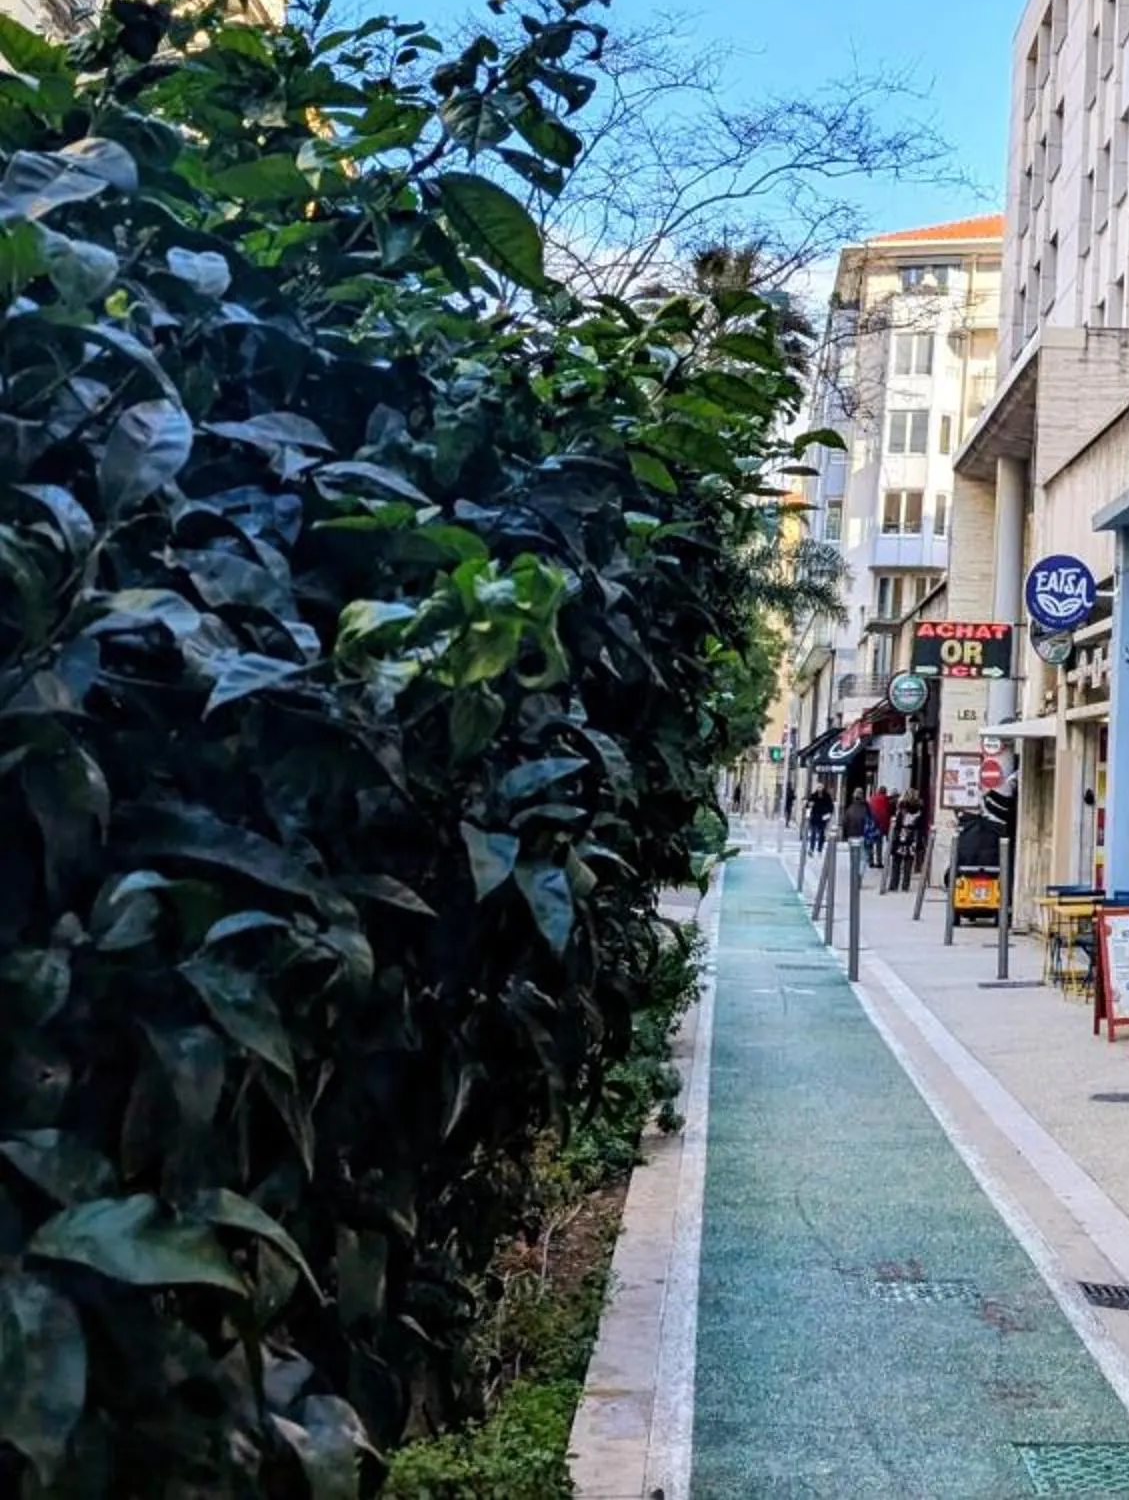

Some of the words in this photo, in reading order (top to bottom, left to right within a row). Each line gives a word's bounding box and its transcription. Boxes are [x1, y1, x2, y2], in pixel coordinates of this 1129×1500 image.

[1035, 566, 1094, 608] EATSA
[917, 623, 1009, 640] ACHAT
[940, 639, 984, 666] OR
